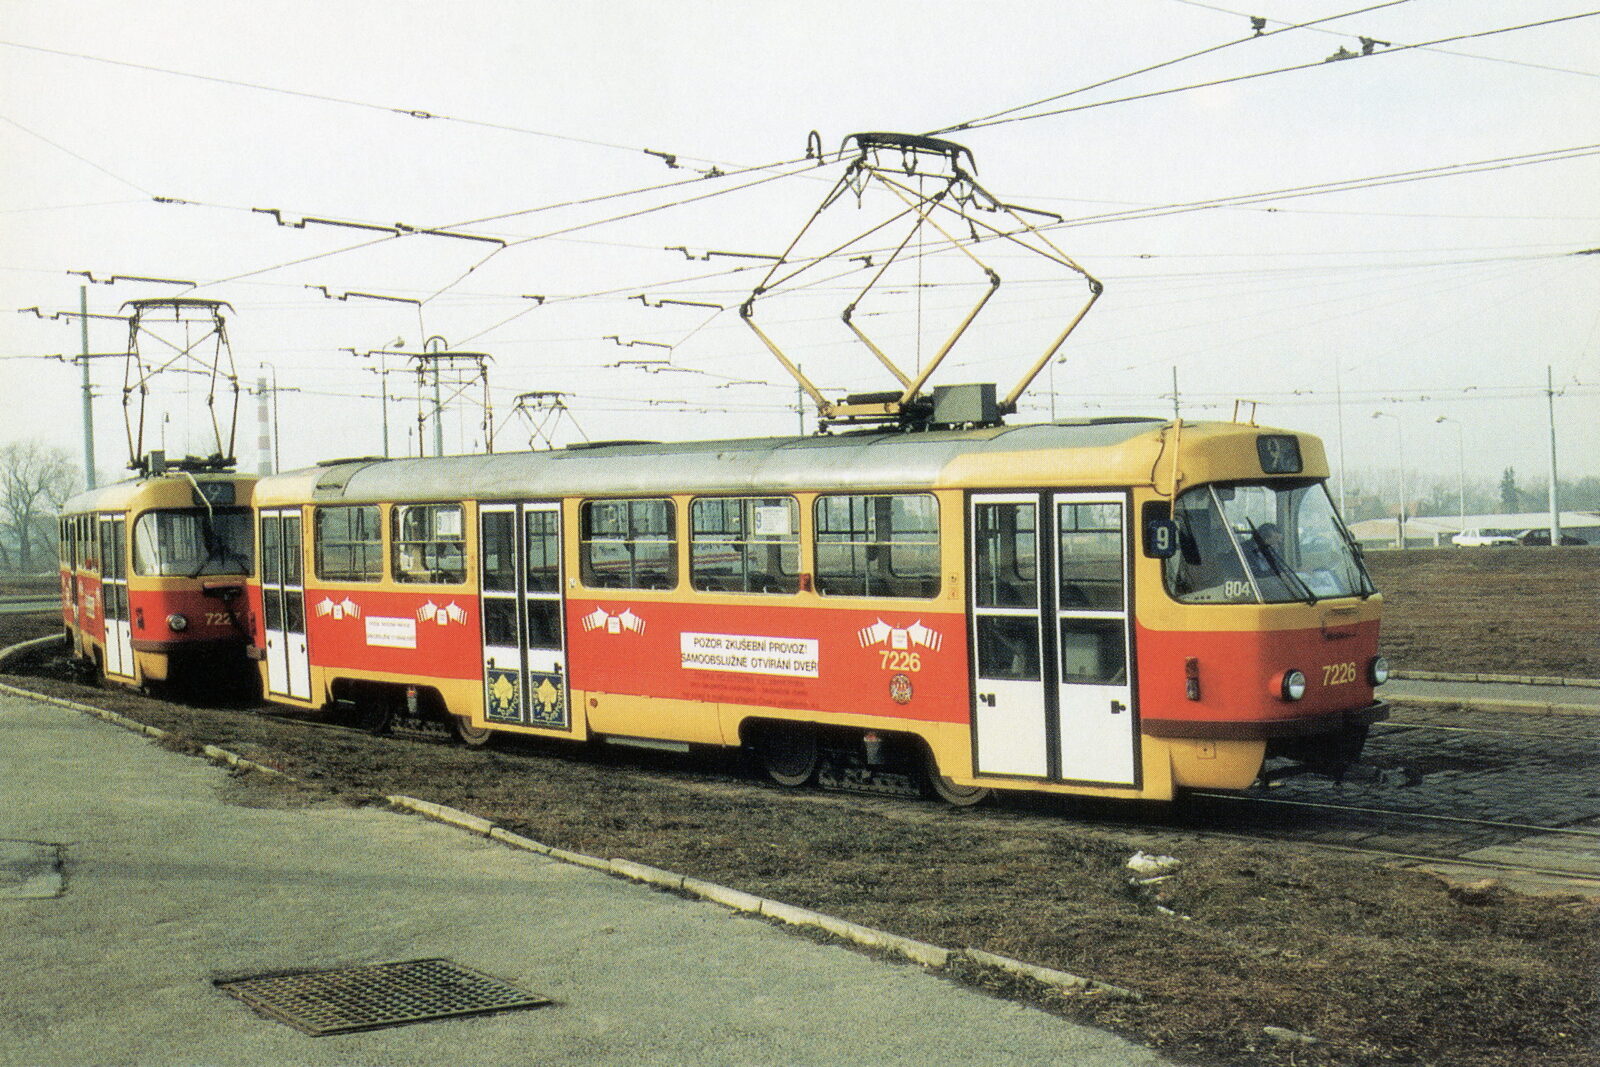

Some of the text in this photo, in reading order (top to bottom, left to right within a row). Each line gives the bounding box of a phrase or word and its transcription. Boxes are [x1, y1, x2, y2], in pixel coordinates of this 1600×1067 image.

[1156, 526, 1169, 550] 9
[1225, 580, 1250, 597] 804
[693, 637, 722, 650] POZOR
[725, 638, 766, 653] ZKUŠEBNÍ
[879, 650, 921, 672] 7226
[1322, 662, 1357, 687] 7226
